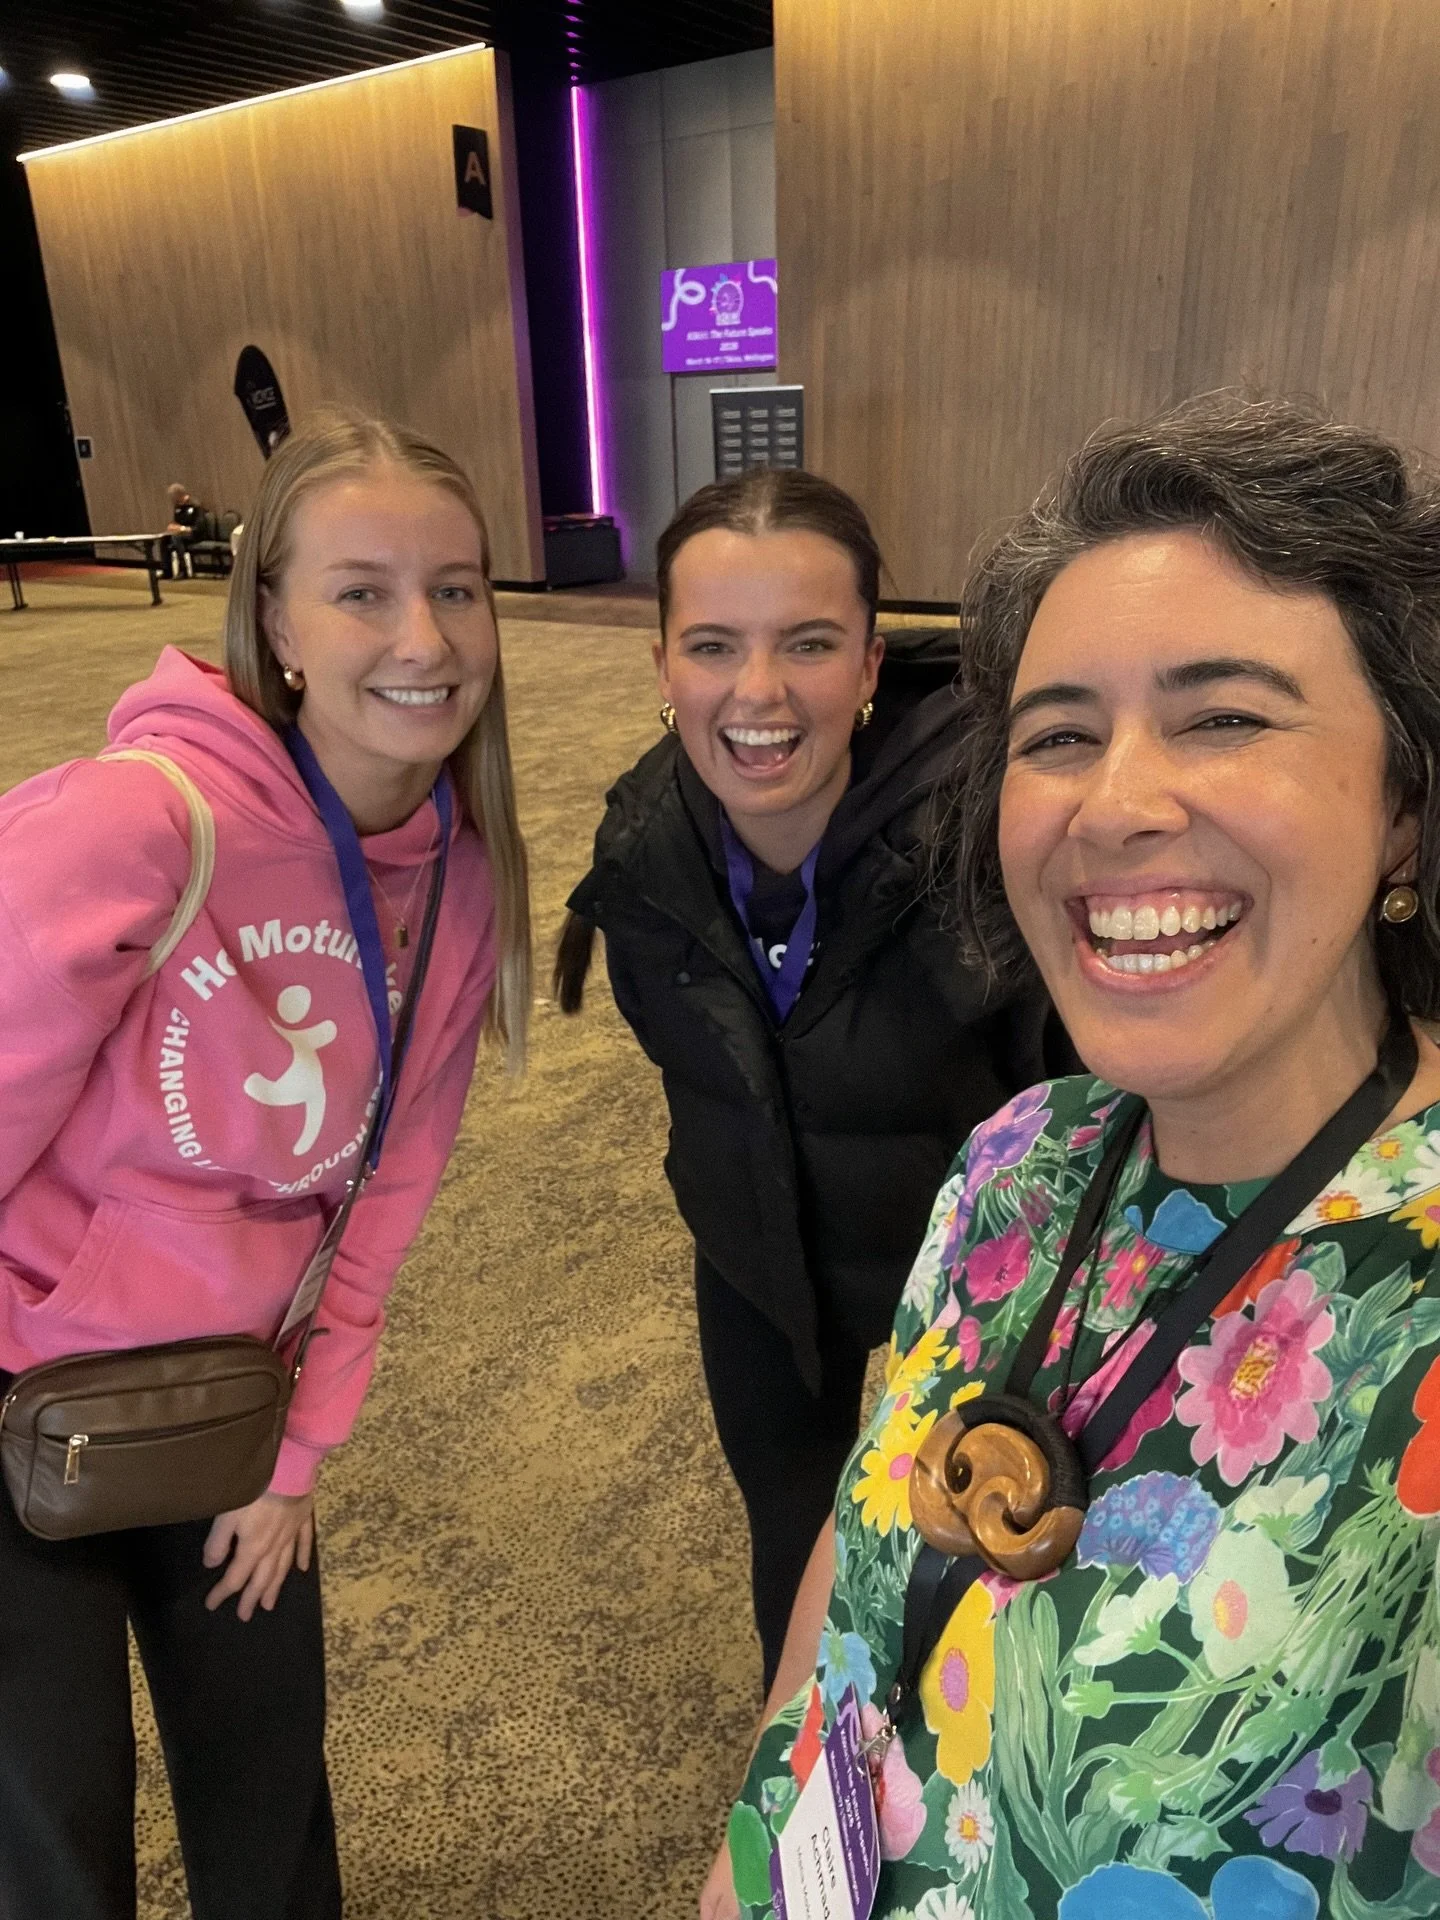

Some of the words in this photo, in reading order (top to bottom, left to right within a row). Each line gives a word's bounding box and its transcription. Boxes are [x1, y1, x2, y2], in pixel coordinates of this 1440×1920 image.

[464, 151, 486, 185] A
[159, 1007, 203, 1158] CHANGING
[821, 1826, 836, 1890] Claire
